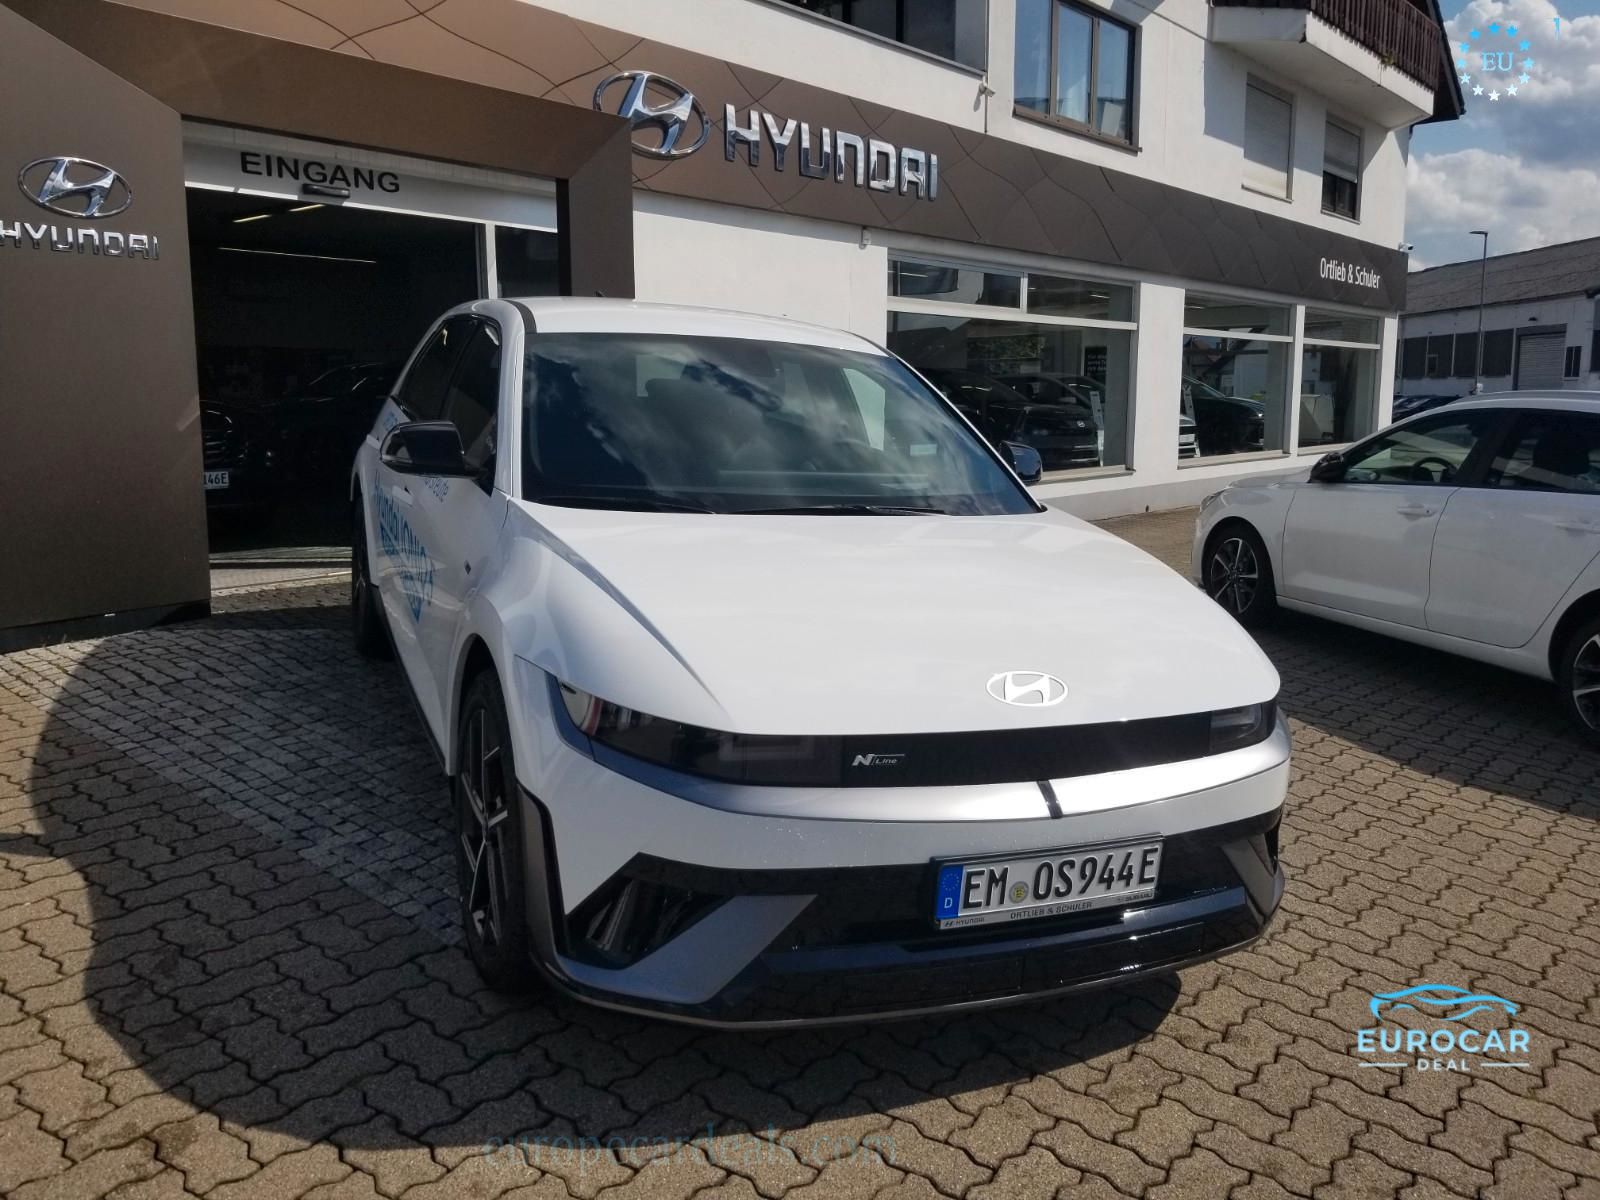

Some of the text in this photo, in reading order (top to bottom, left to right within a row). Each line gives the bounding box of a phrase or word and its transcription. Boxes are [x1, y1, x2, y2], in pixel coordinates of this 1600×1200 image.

[724, 103, 939, 201] HYUNDAI
[240, 151, 400, 193] EINGANG
[0, 220, 160, 260] HYUNDAI
[1320, 257, 1380, 289] Ortlieb & Schuler
[852, 753, 875, 766] N
[963, 847, 1159, 909] EM OS944E
[944, 897, 953, 909] D
[956, 916, 985, 925] HYUNDAI
[1010, 908, 1045, 919] ORTLIEB
[1055, 901, 1093, 913] SCHULER
